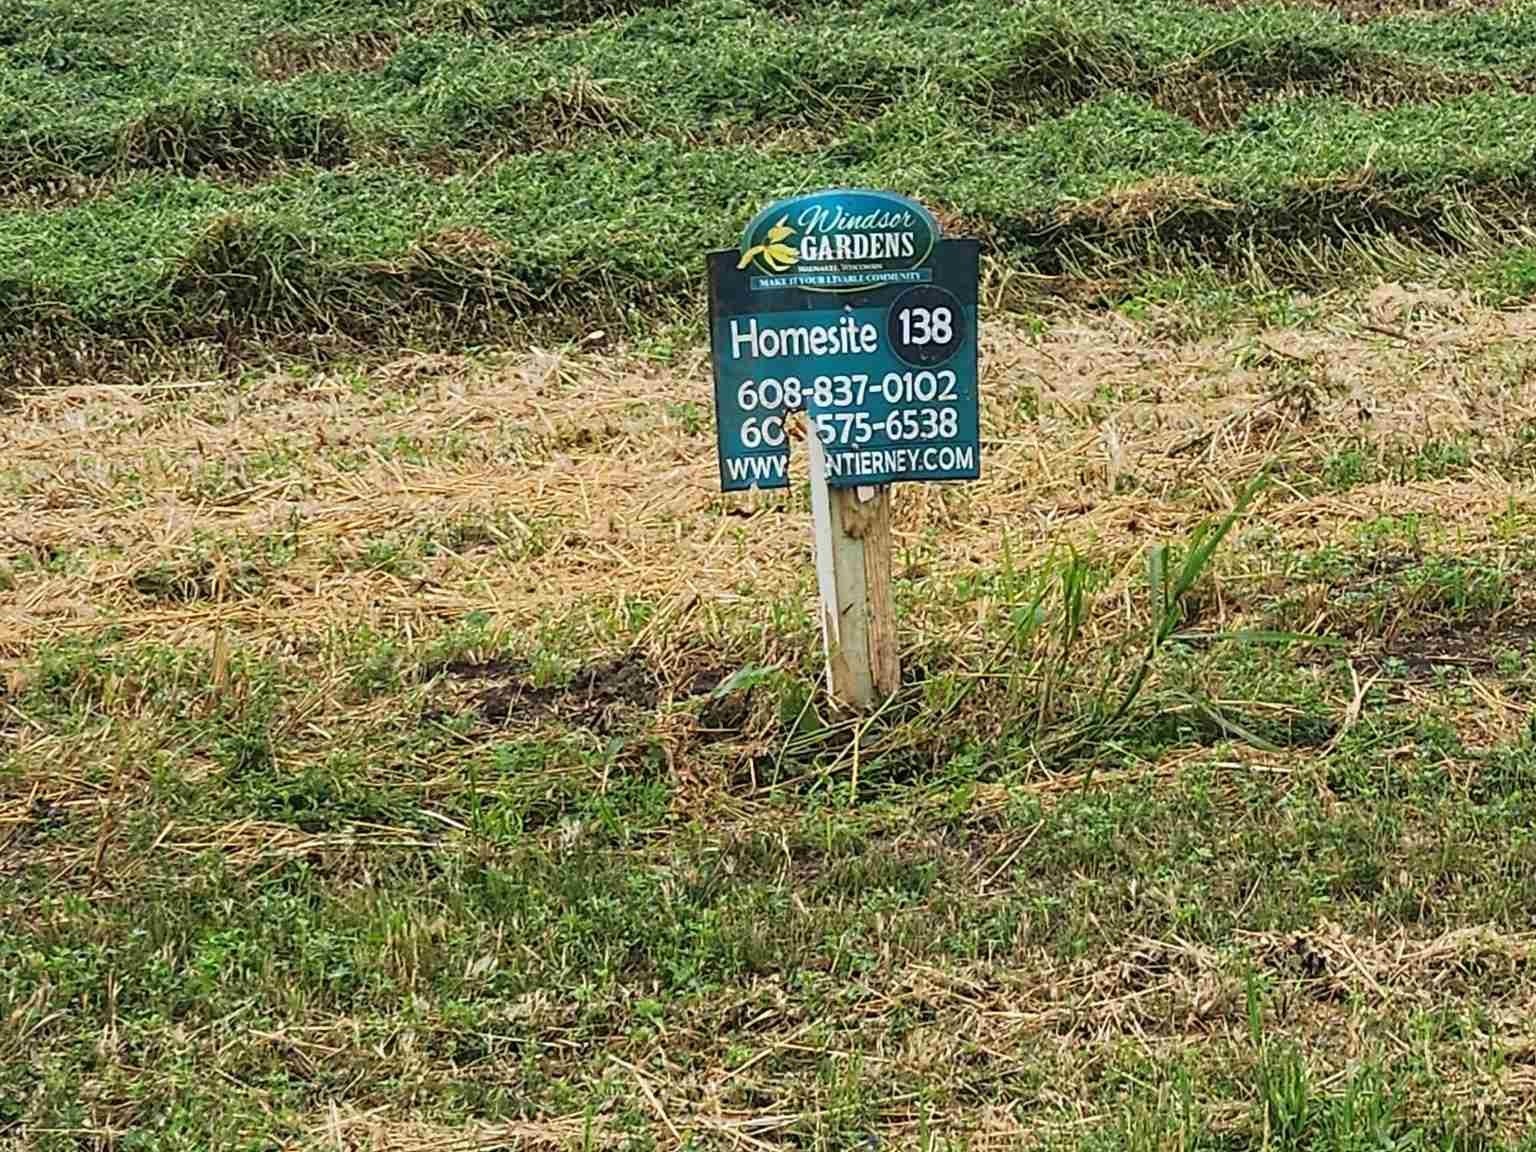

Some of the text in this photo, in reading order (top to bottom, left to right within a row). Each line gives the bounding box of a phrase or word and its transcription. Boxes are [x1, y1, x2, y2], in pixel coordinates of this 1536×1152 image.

[798, 204, 914, 235] Windsor
[800, 231, 914, 261] GARDENS
[866, 271, 921, 283] COMMUNITY
[730, 307, 953, 359] Homesite 138
[737, 370, 958, 410] 608-837-0102
[739, 407, 958, 448] 60575-6538
